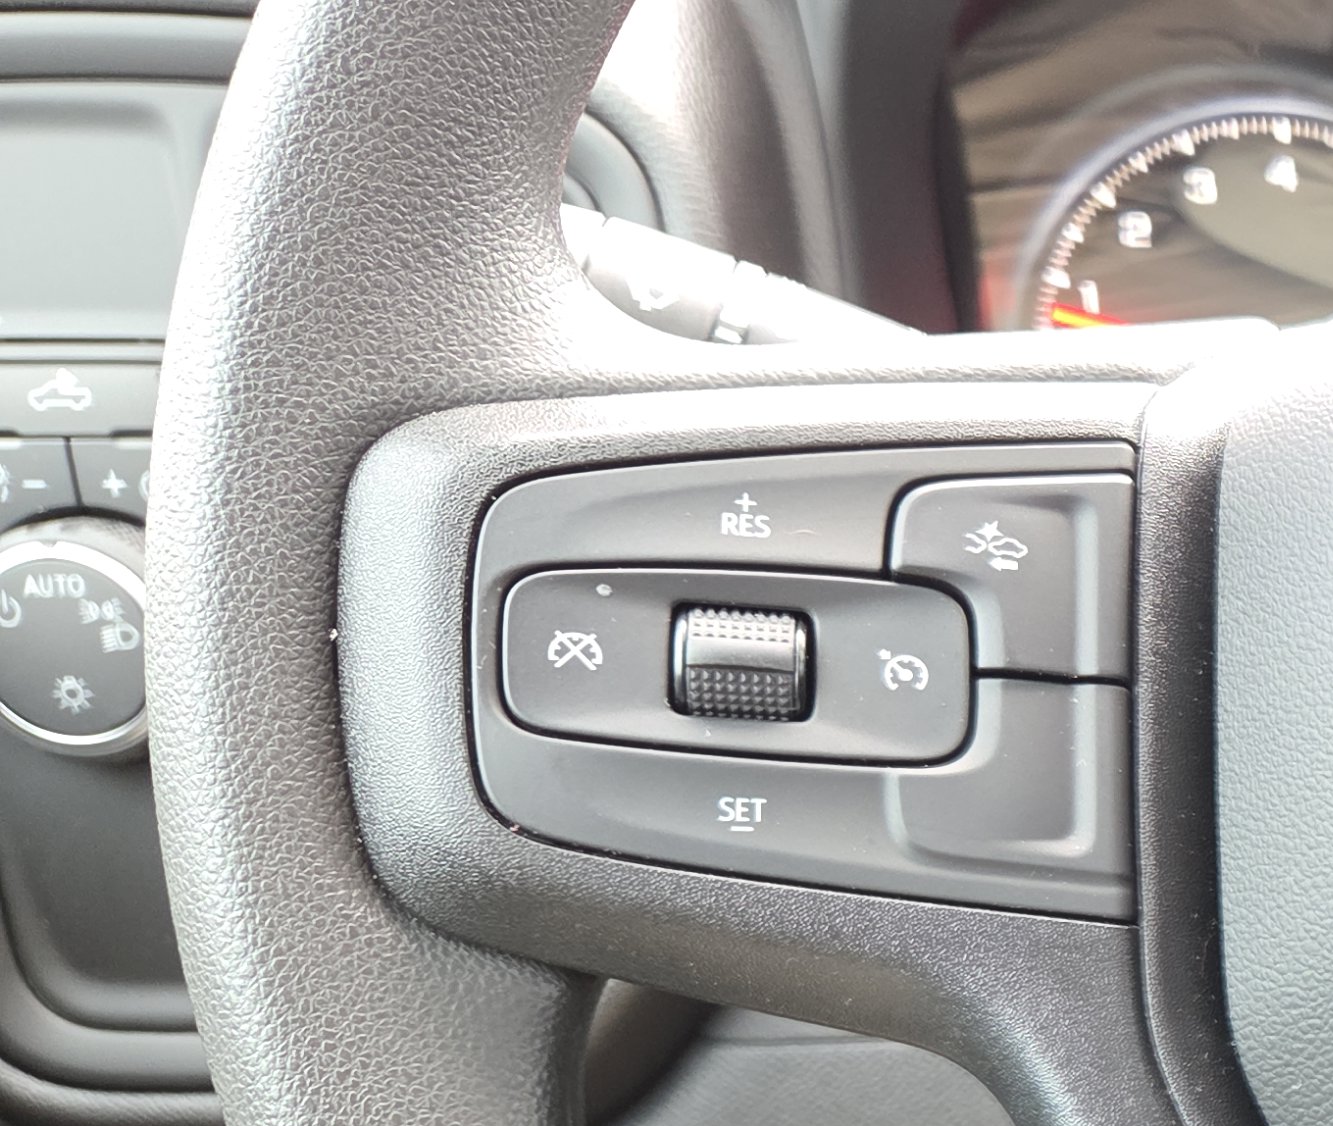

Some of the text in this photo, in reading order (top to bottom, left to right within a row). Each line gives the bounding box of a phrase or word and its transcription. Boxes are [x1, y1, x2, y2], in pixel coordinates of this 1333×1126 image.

[1183, 167, 1217, 204] 3
[1265, 155, 1298, 192] 4
[1118, 211, 1152, 248] 2
[720, 514, 772, 538] RES
[24, 573, 86, 598] AUTO
[717, 797, 767, 824] SET
